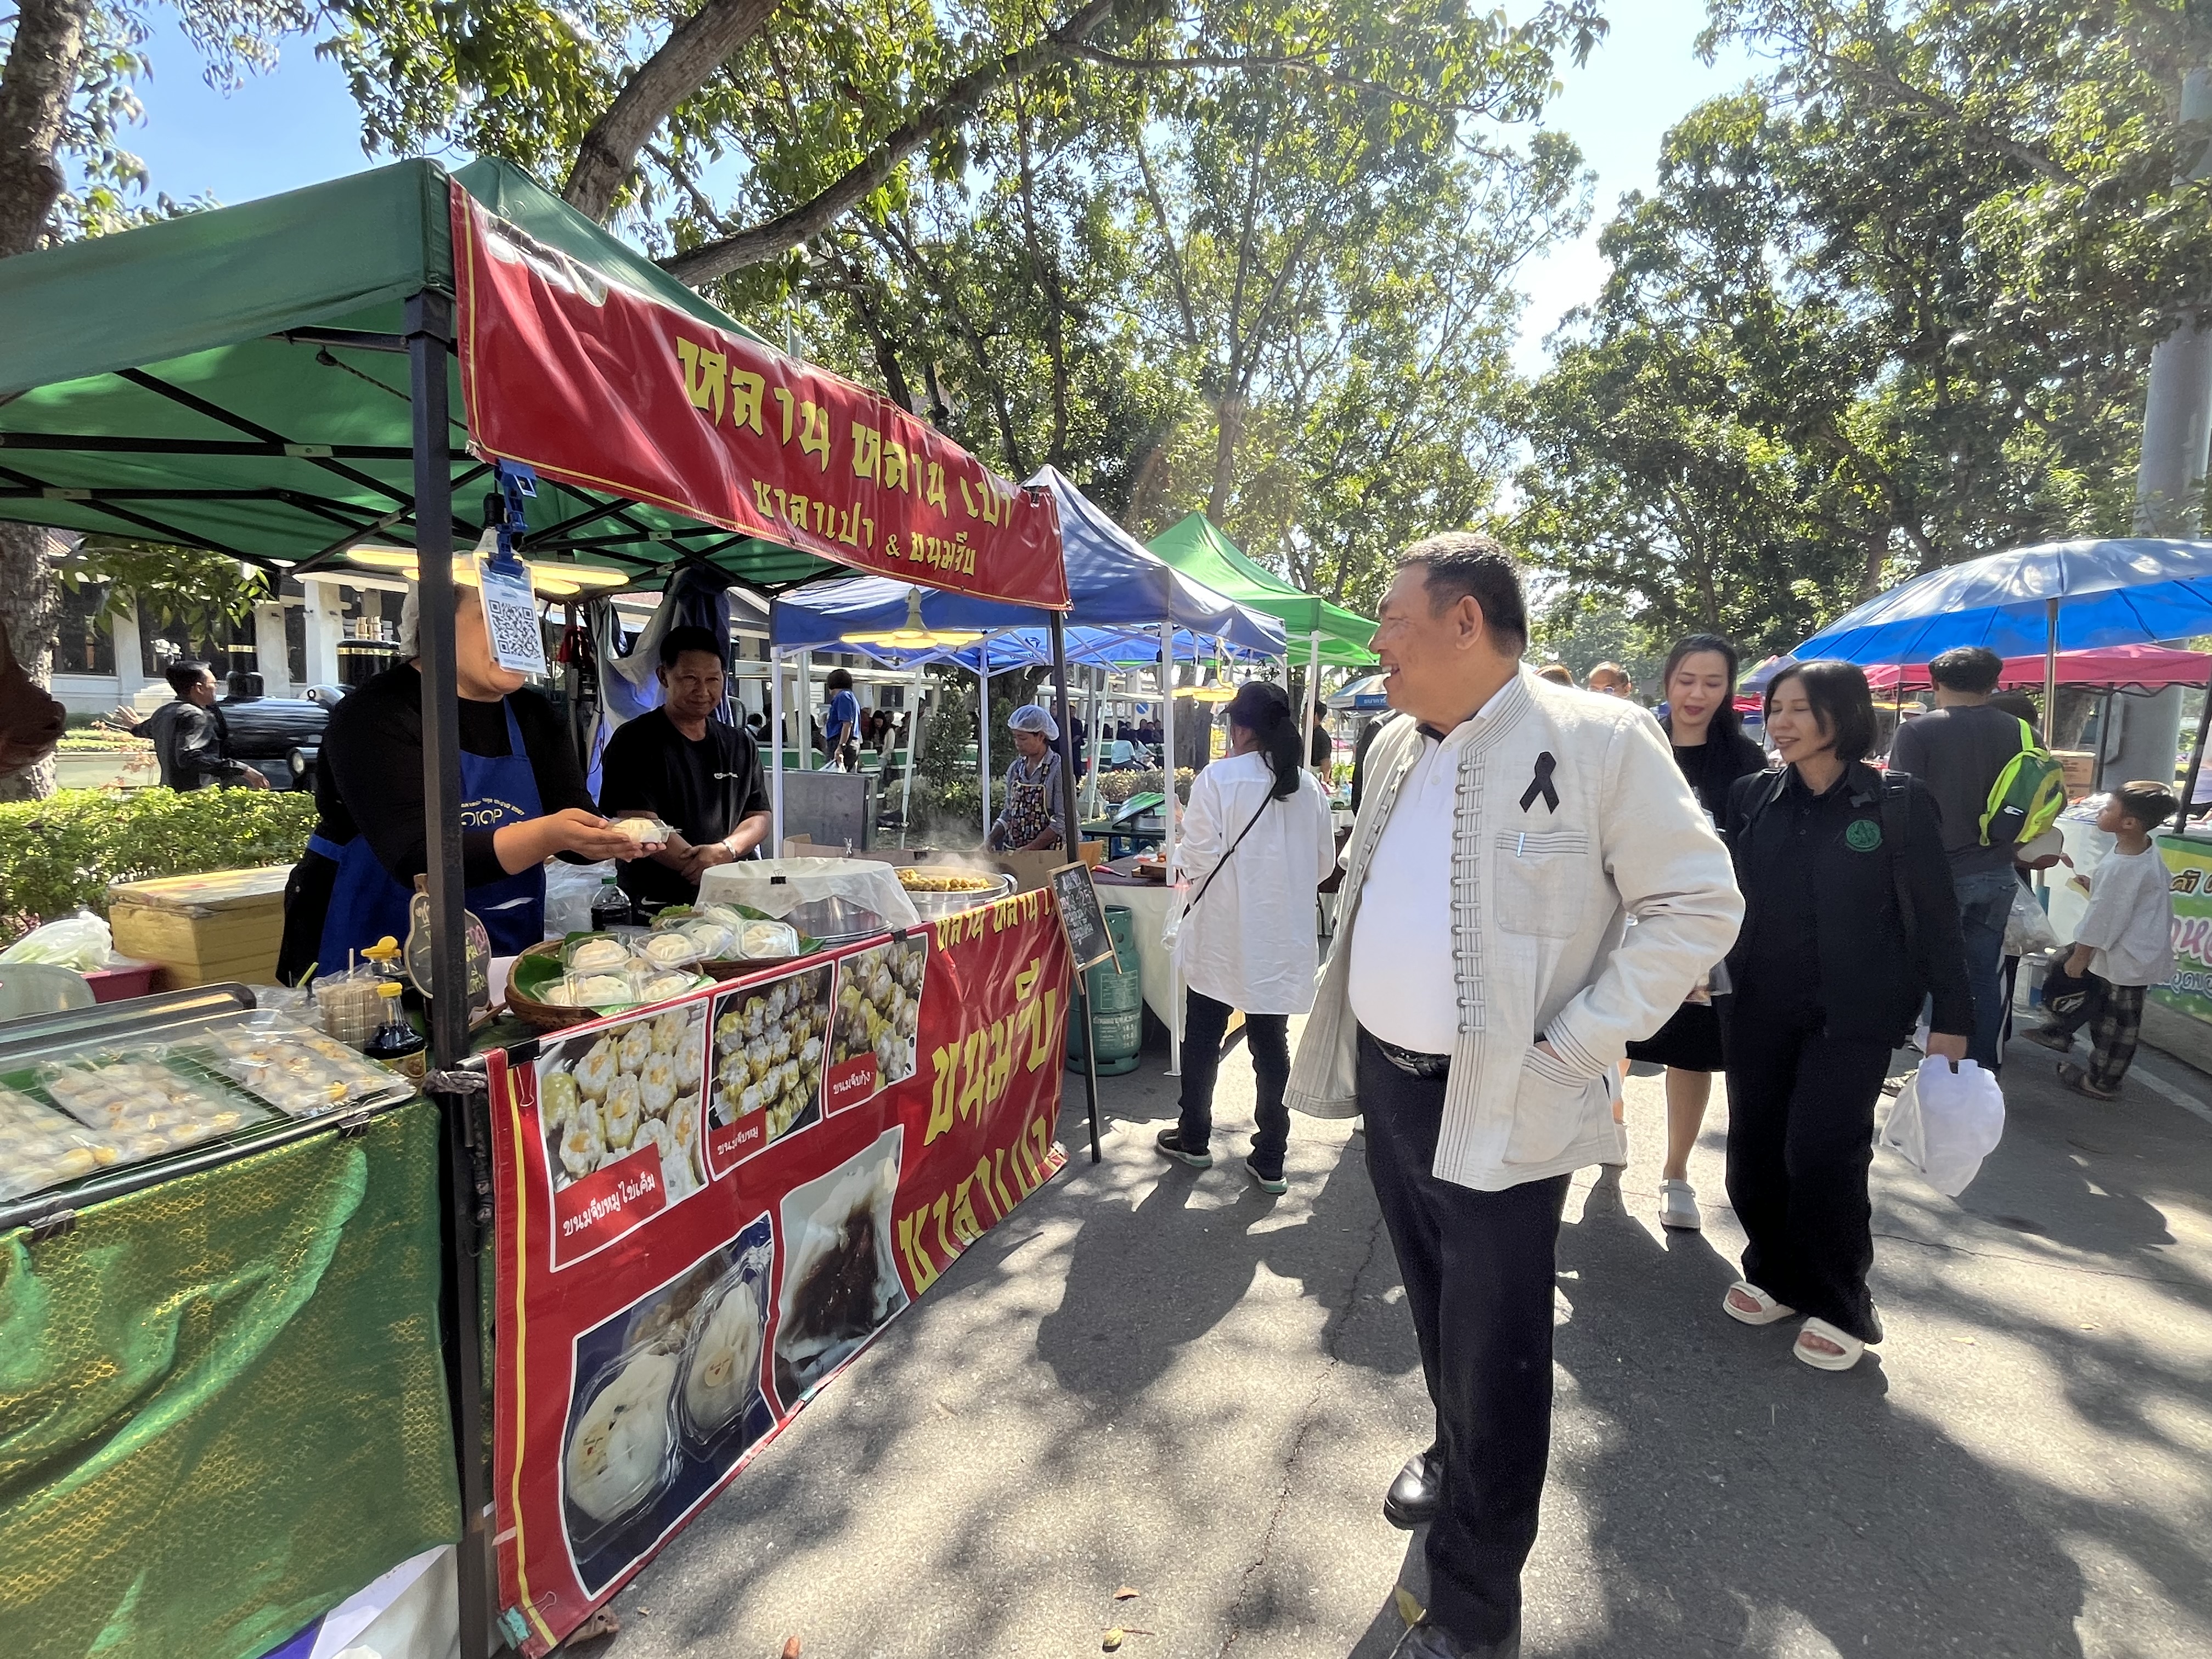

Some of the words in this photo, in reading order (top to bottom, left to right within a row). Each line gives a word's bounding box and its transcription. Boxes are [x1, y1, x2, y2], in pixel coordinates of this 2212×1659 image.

[676, 336, 831, 473] หลาน
[852, 421, 947, 518] หลาน
[960, 473, 1012, 530] เปา
[752, 478, 874, 549] ซาลาเปา
[885, 534, 900, 557] &
[909, 531, 977, 576] ขนมจีบ
[935, 908, 986, 951] หลาน
[993, 892, 1039, 933] หลาน
[924, 957, 1057, 1147] ขนมจีบ
[563, 1192, 621, 1237] ขนมจีบหมู
[618, 1171, 656, 1204] ไข่เค็ม
